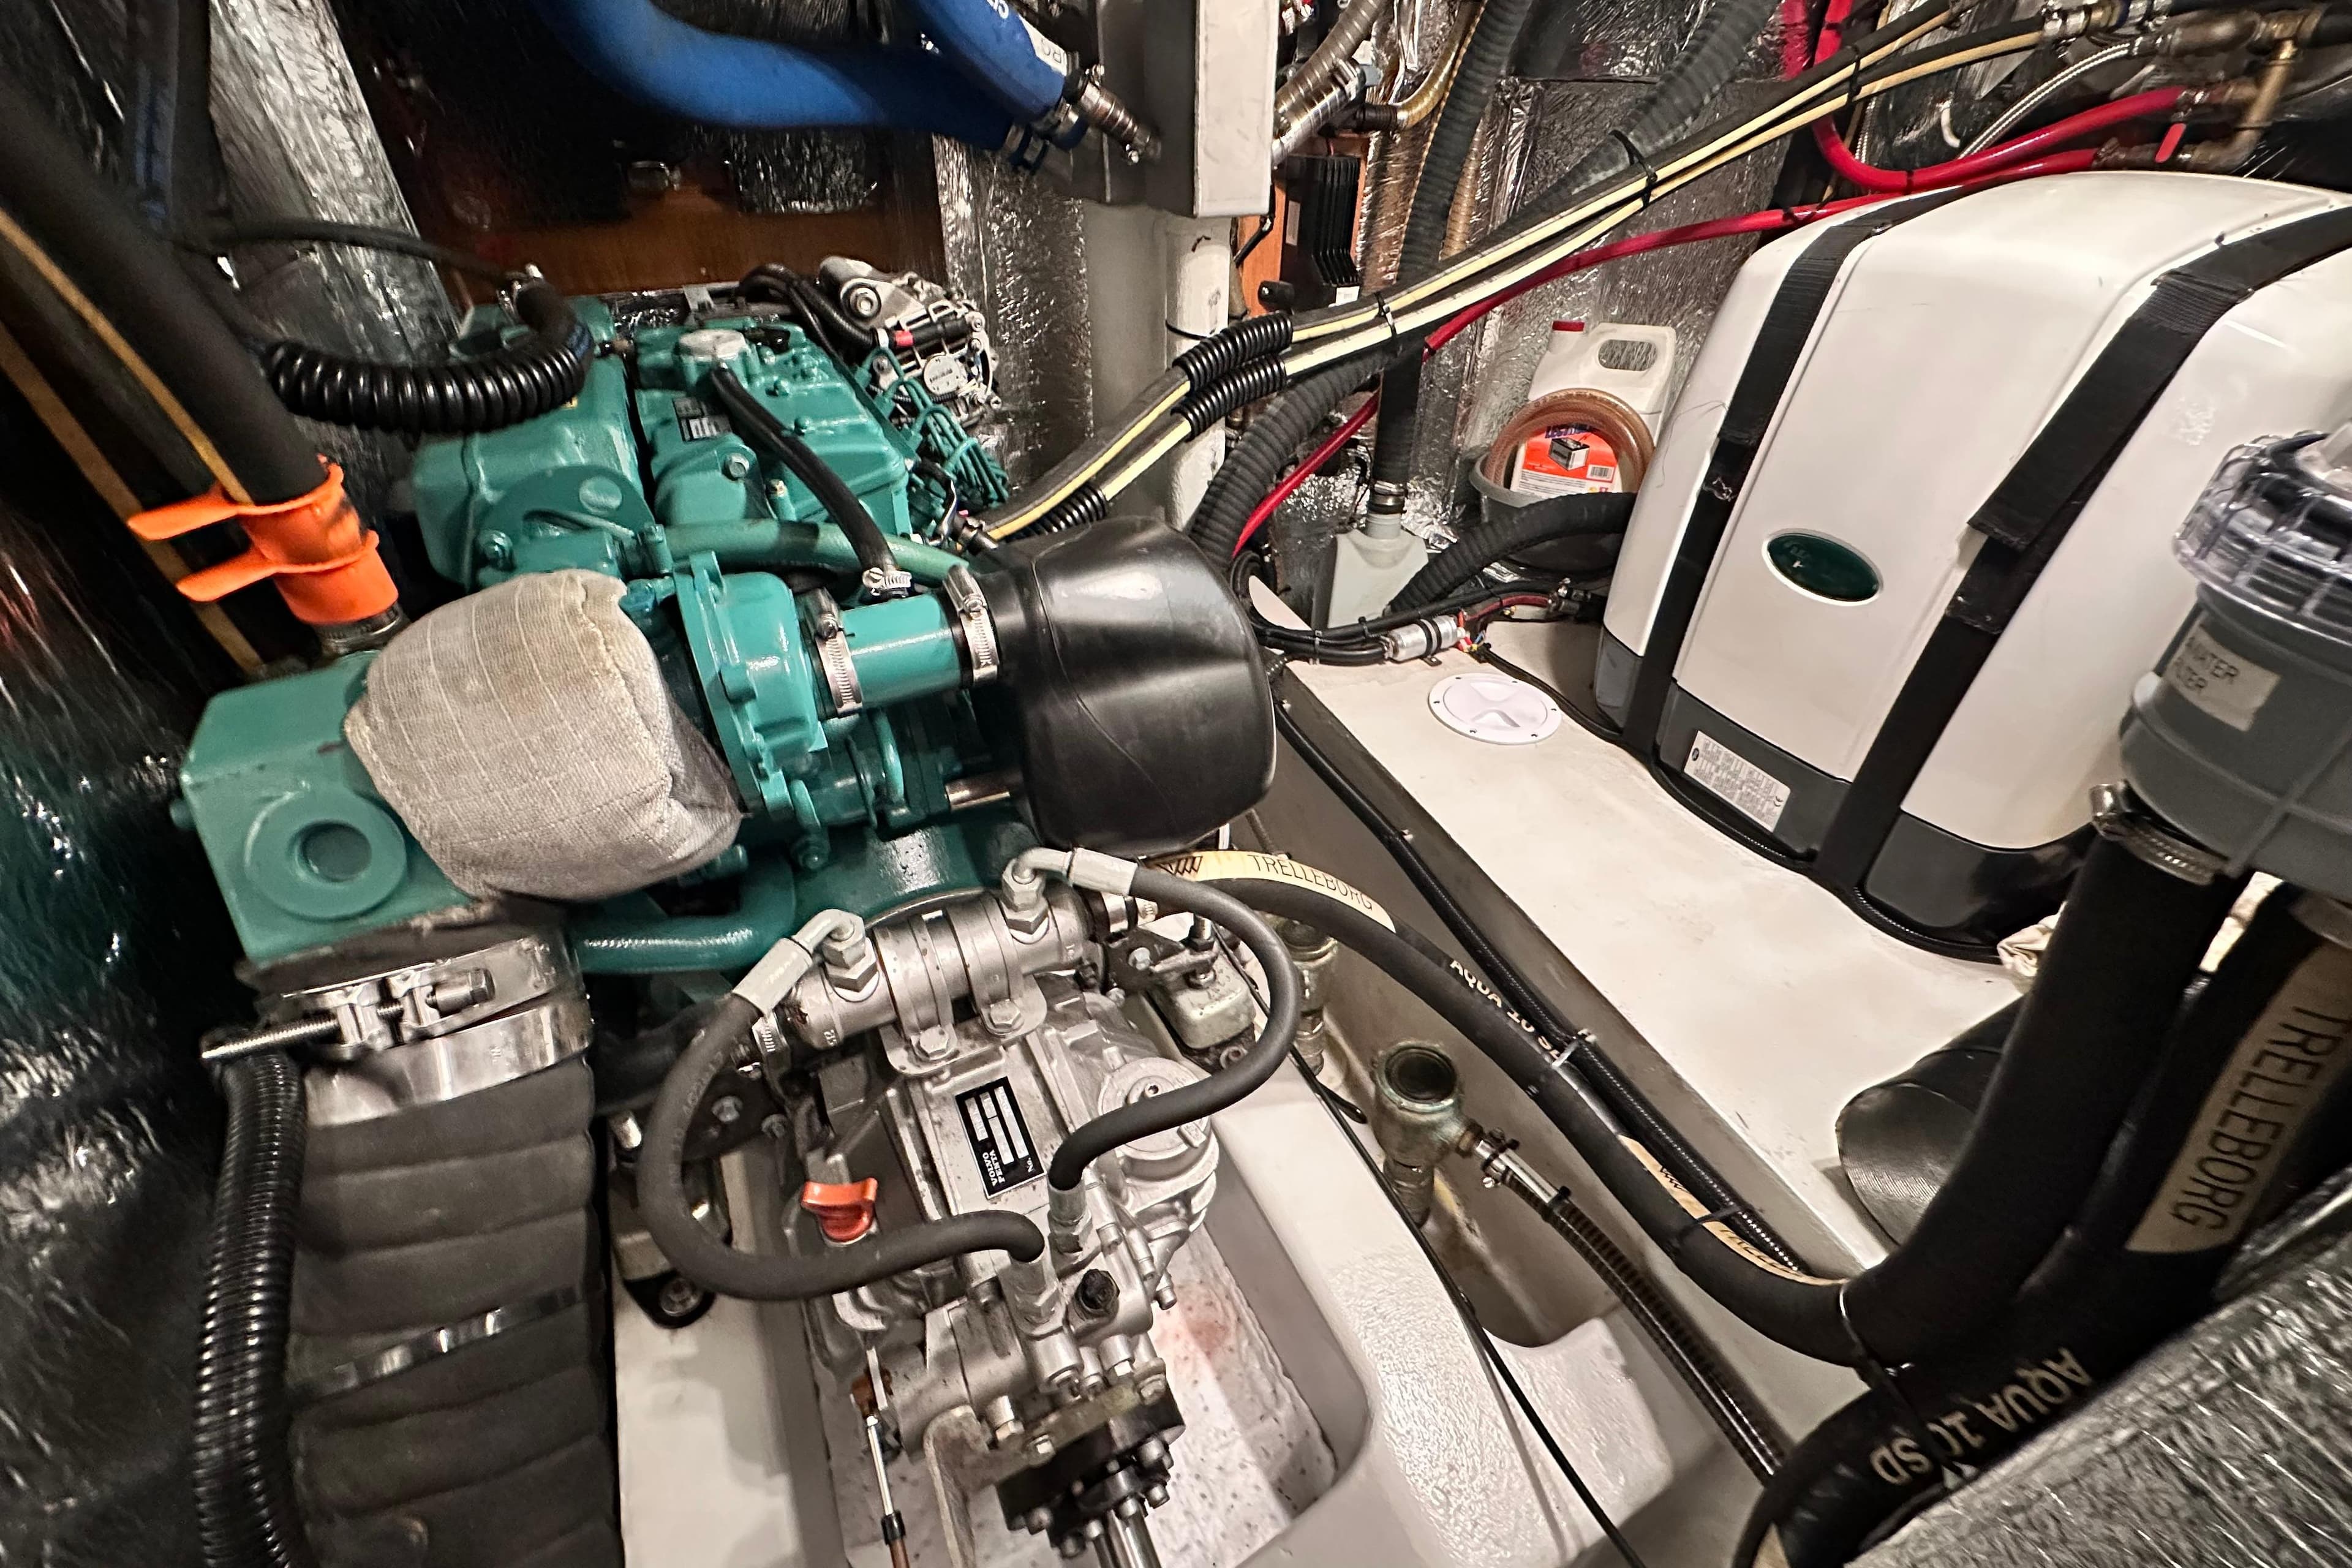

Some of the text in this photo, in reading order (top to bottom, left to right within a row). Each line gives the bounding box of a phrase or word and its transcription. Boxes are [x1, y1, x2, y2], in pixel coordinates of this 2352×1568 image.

[1246, 854, 1373, 911] TRELLEBORG
[1450, 960, 1502, 1008] AQUA
[2167, 1006, 2352, 1230] TRELLEBORG
[982, 1152, 998, 1187] VOLVO
[989, 1149, 1006, 1184] PENTA
[1974, 1346, 2092, 1433] AQUA
